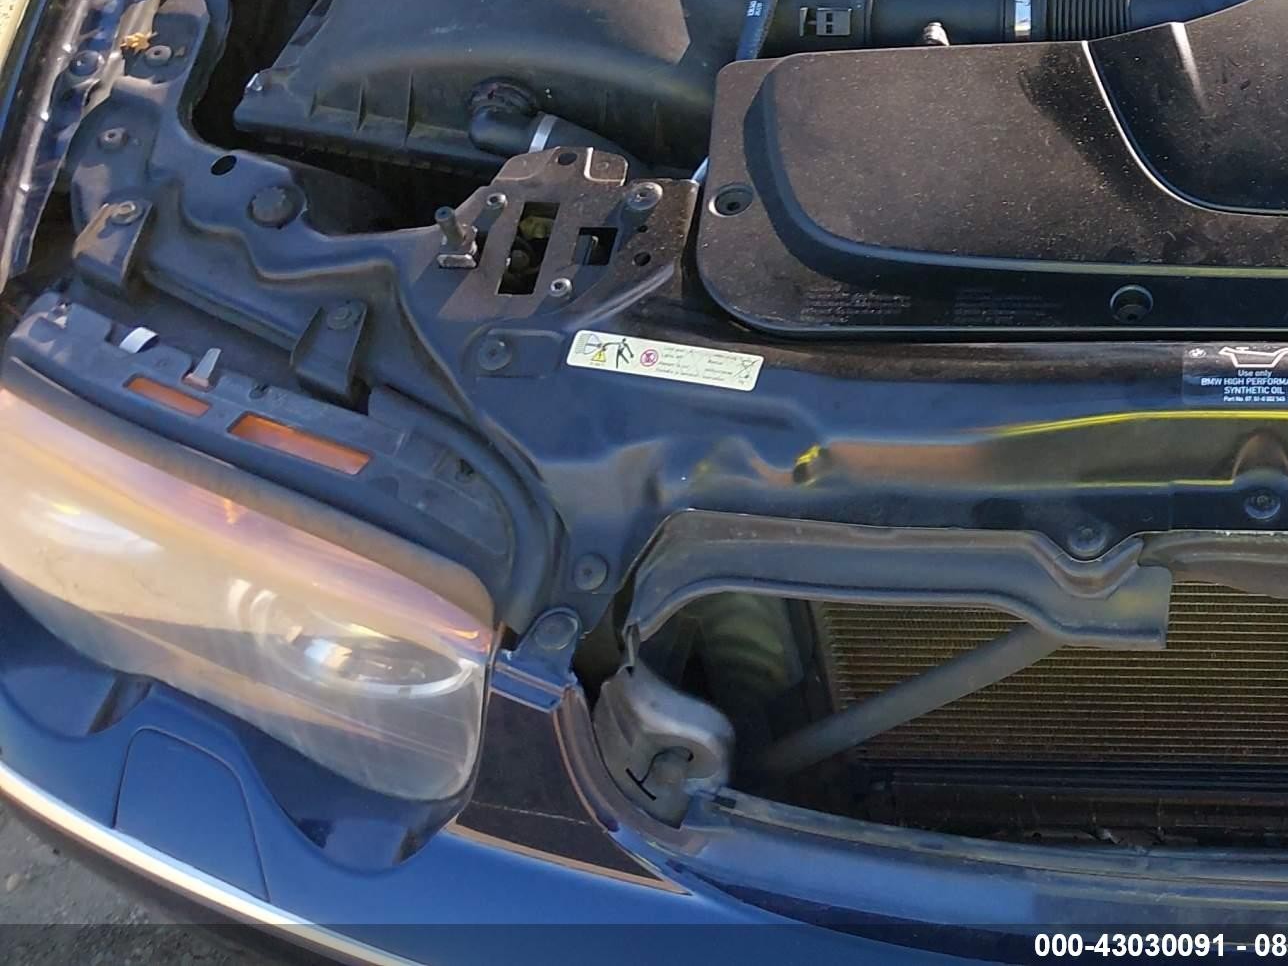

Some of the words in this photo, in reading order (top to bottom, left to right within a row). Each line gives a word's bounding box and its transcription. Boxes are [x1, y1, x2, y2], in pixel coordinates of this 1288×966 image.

[1254, 370, 1273, 378] only
[1201, 378, 1222, 386] BMW
[1224, 386, 1270, 394] SYNTHETIC
[1271, 386, 1285, 394] OIL
